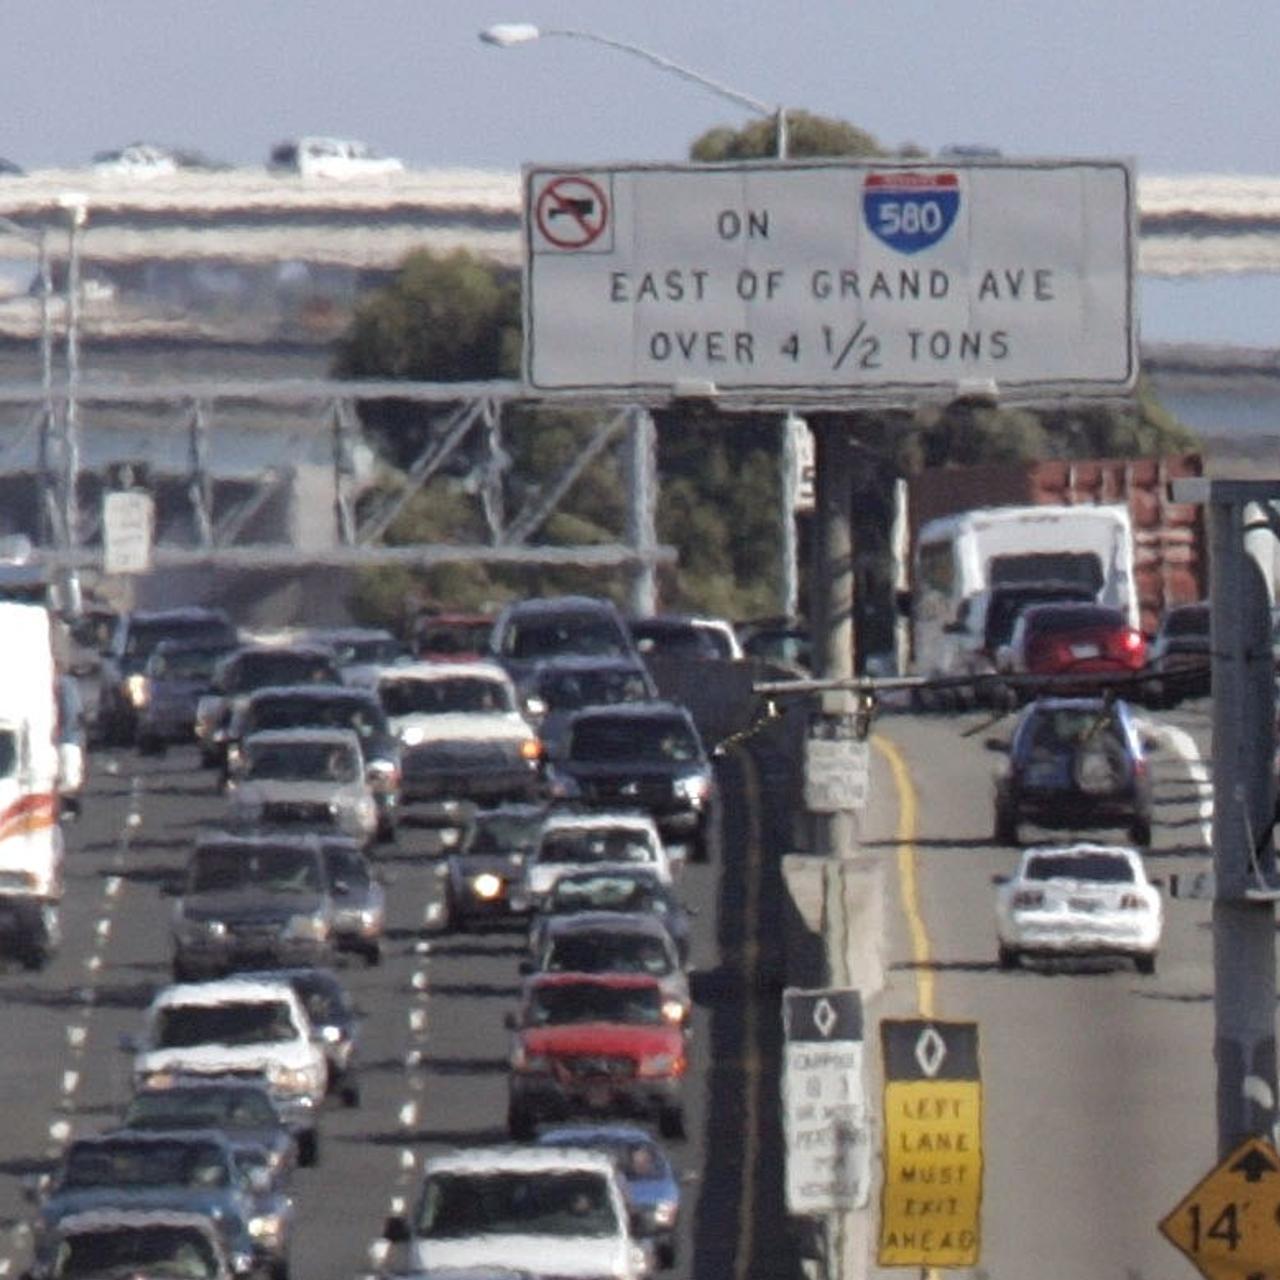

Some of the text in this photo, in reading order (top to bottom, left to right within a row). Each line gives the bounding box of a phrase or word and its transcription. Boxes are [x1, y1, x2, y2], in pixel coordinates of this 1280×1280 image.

[718, 211, 768, 240] ON
[876, 200, 943, 236] 580
[611, 269, 1052, 302] EAST OF GRAND AVE
[650, 321, 1008, 370] OVER 4 1/2 TONS
[902, 1098, 961, 1119] LEFT
[901, 1134, 968, 1153] LANE
[901, 1167, 964, 1184] MUST
[887, 1231, 975, 1251] AHEAD
